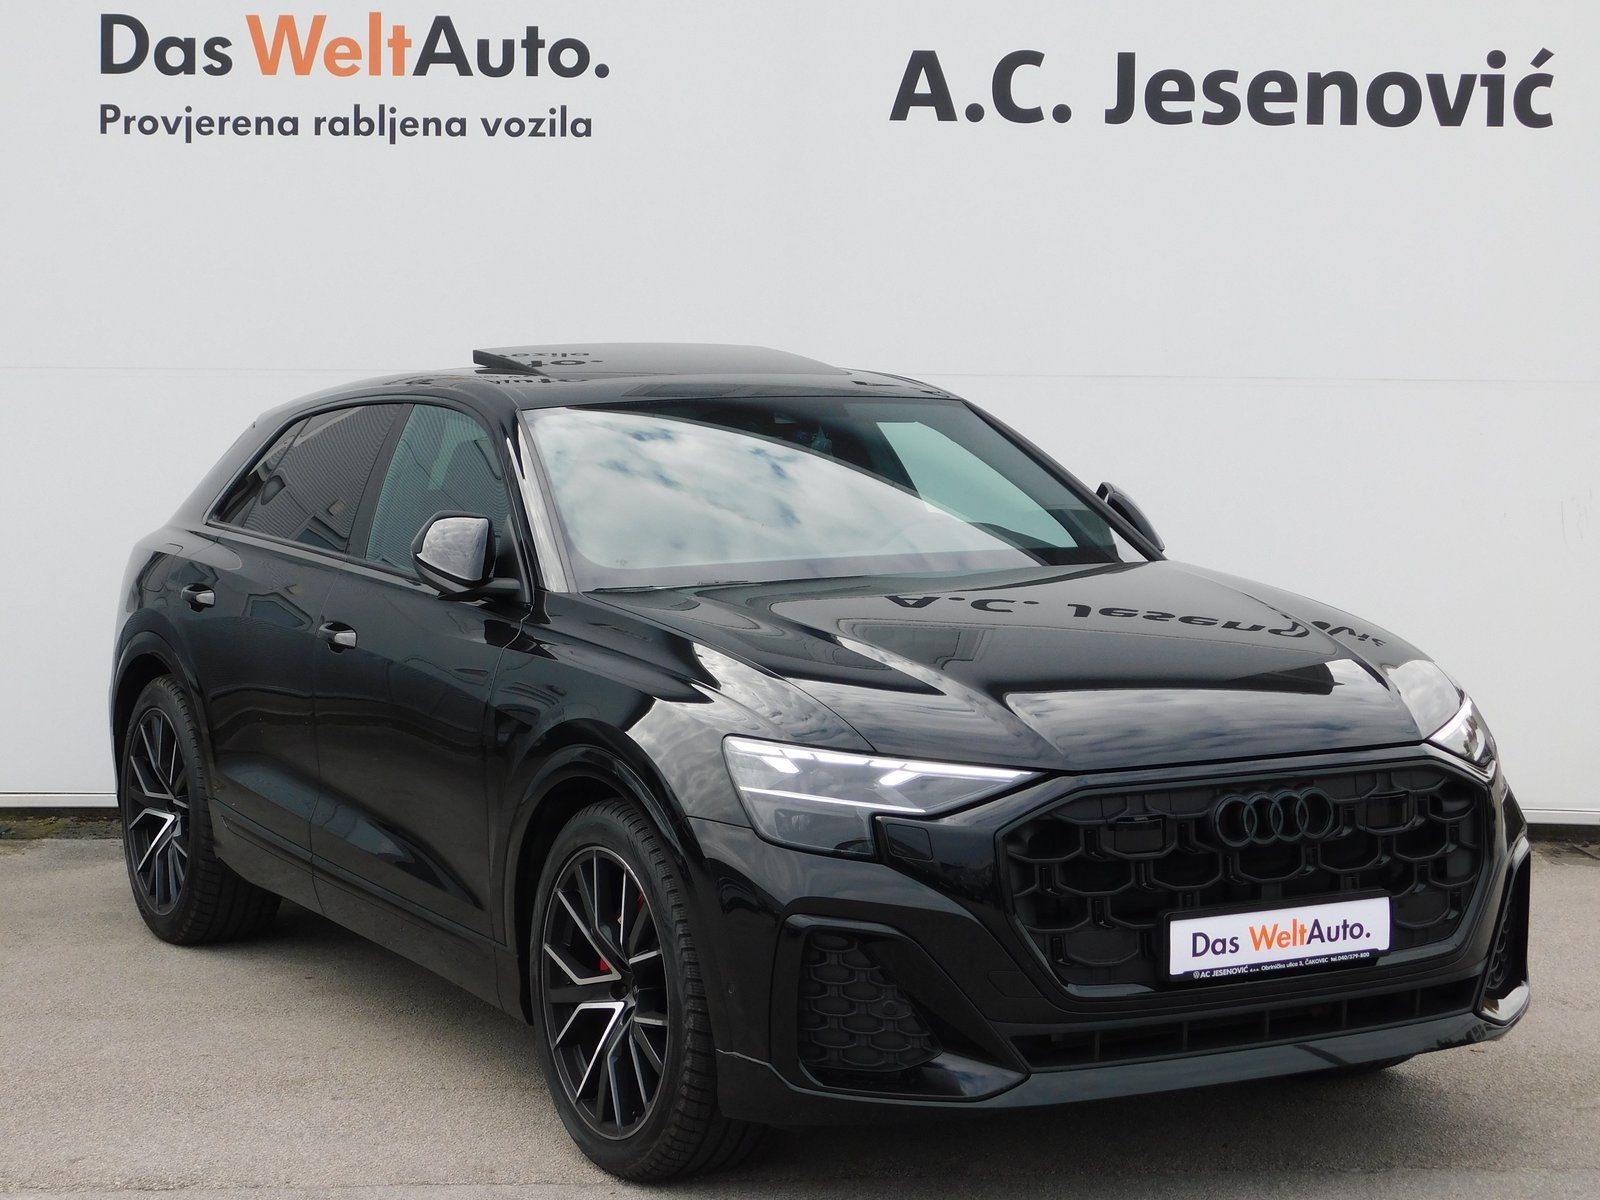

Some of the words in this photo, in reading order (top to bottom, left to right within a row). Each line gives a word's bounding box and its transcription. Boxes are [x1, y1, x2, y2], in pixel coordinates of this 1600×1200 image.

[100, 14, 233, 77] Das
[246, 11, 610, 79] WeltAuto.
[889, 49, 1072, 124] A.C.
[1104, 47, 1555, 129] Jesenović
[100, 103, 299, 144] Provjerena
[314, 103, 467, 145] rabljena
[480, 105, 593, 138] vozila
[1191, 931, 1240, 958] Das
[1248, 918, 1372, 952] WeltAuto.
[1200, 971, 1211, 979] AC
[1212, 965, 1249, 977] JESENOVIĆ
[1305, 957, 1329, 966] ČAKOVEC
